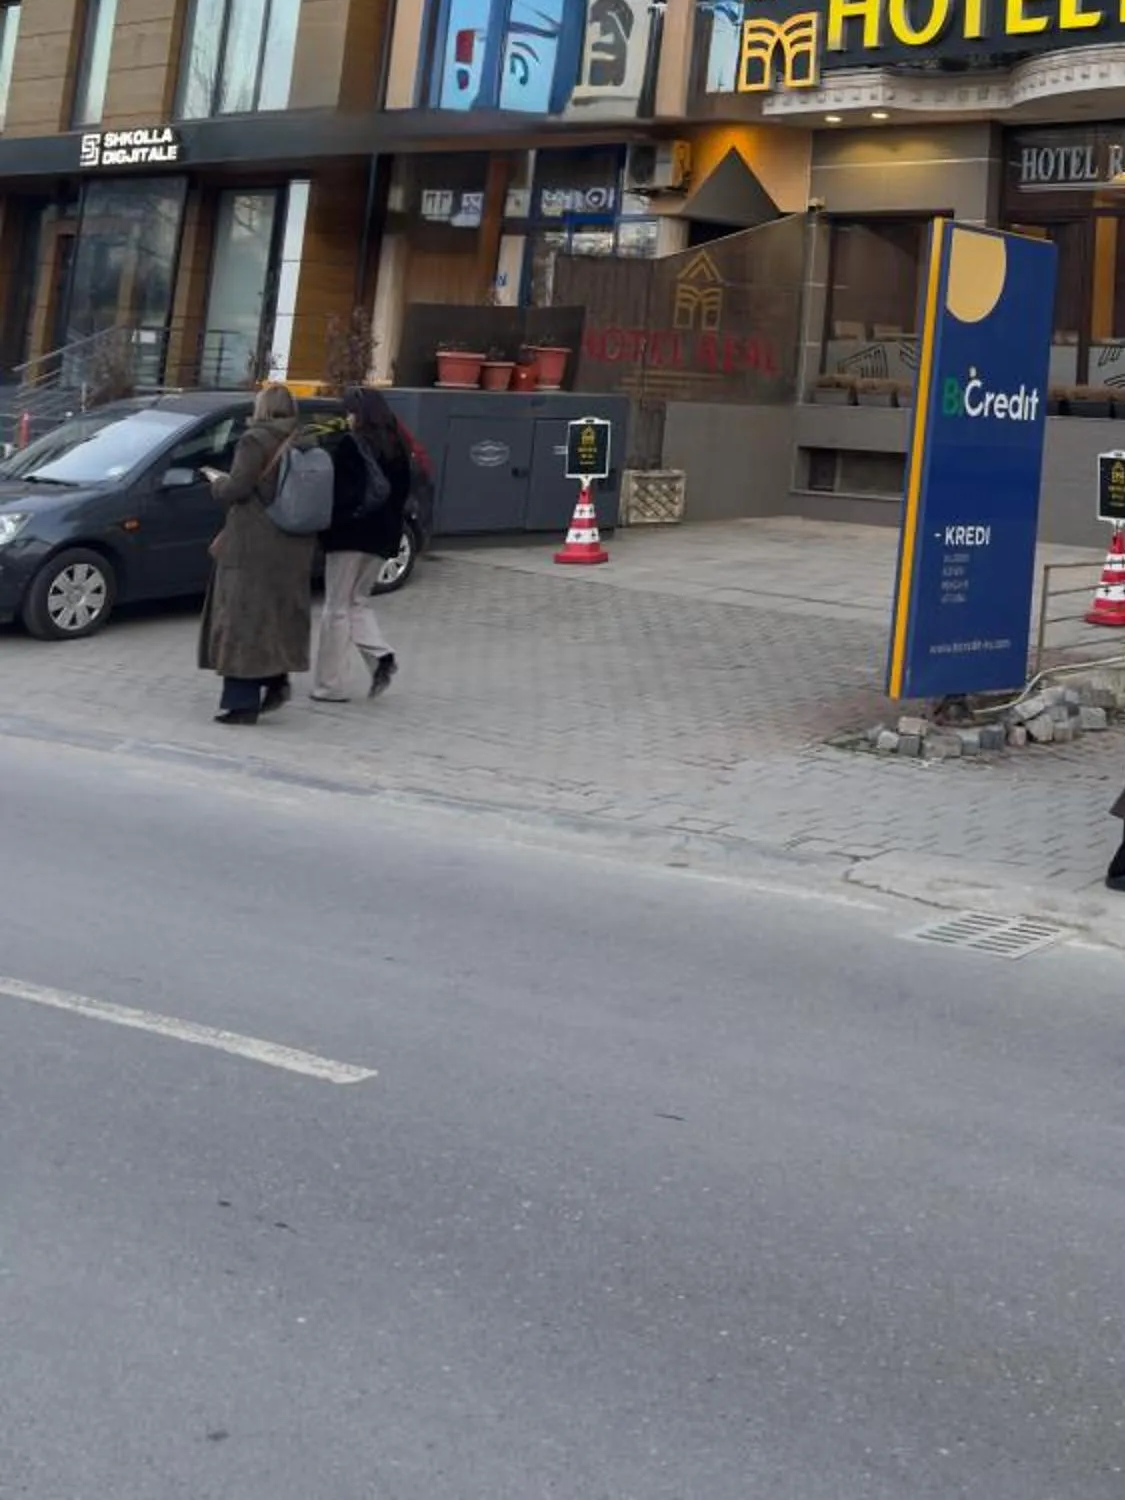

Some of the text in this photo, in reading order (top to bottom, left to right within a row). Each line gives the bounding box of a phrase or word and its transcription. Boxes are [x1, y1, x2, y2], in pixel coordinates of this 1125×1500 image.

[103, 128, 173, 148] SHKOLLA
[102, 145, 178, 165] DIGJITALE
[1021, 145, 1098, 182] HOTEL
[944, 526, 991, 546] KREDI
